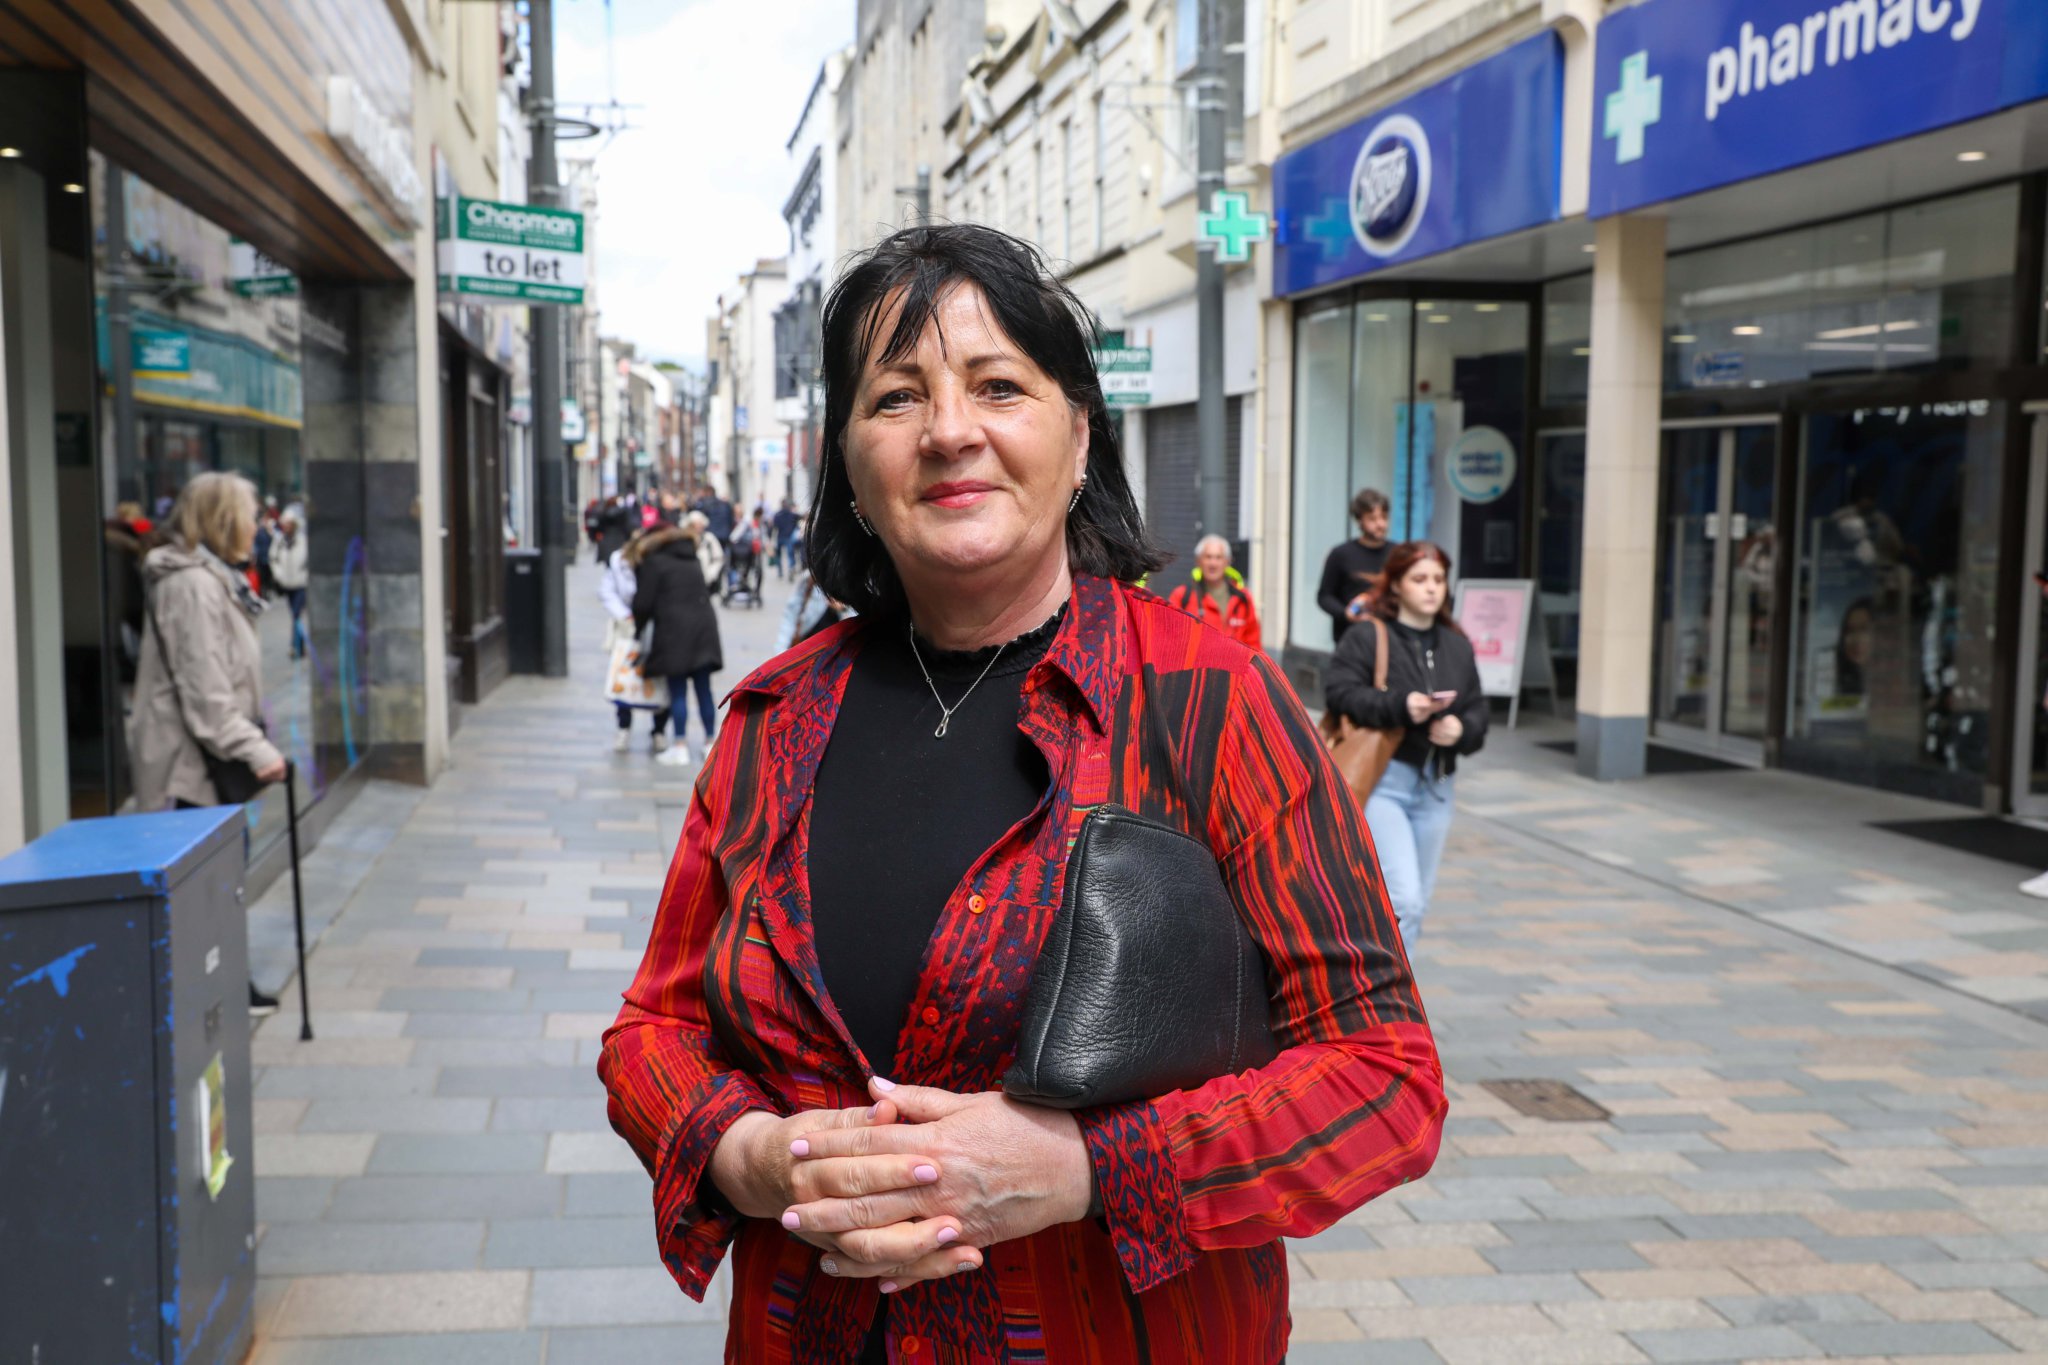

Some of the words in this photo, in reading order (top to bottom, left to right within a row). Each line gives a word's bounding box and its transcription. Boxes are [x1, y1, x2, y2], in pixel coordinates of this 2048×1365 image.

[467, 202, 577, 238] Chapman
[484, 250, 515, 275] to
[525, 251, 560, 281] let
